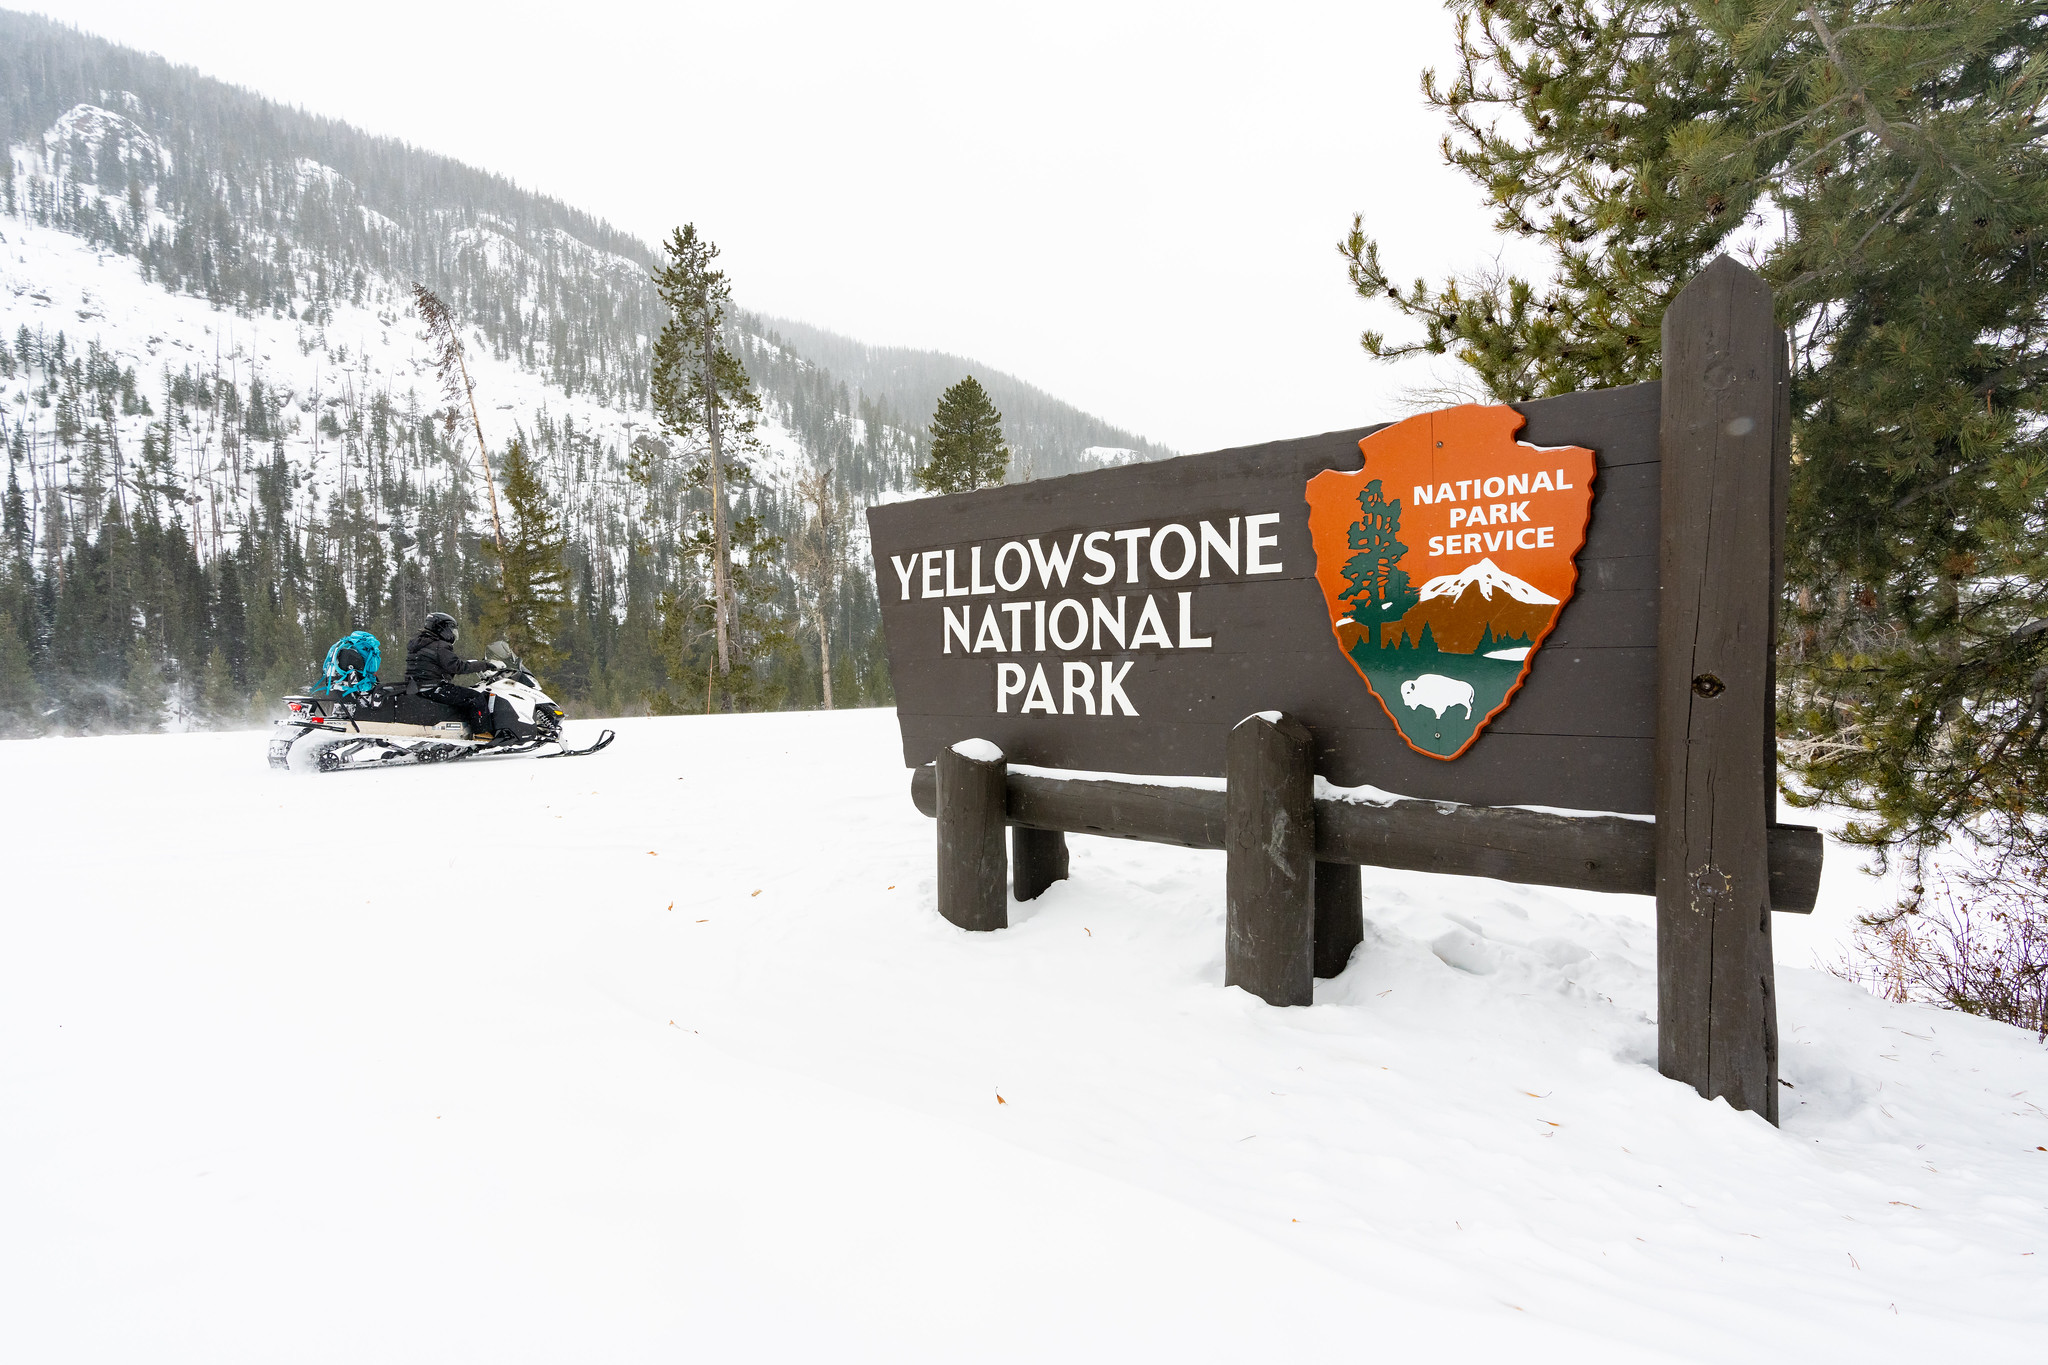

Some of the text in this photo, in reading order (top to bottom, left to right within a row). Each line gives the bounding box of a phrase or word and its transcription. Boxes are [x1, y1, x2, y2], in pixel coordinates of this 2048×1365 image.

[1413, 468, 1574, 506] NATIONAL
[1449, 500, 1531, 529] PARK
[890, 512, 1283, 601] YELLOWSTONE
[1428, 526, 1555, 557] SERVICE
[942, 591, 1213, 655] NATIONAL
[996, 660, 1140, 717] PARK
